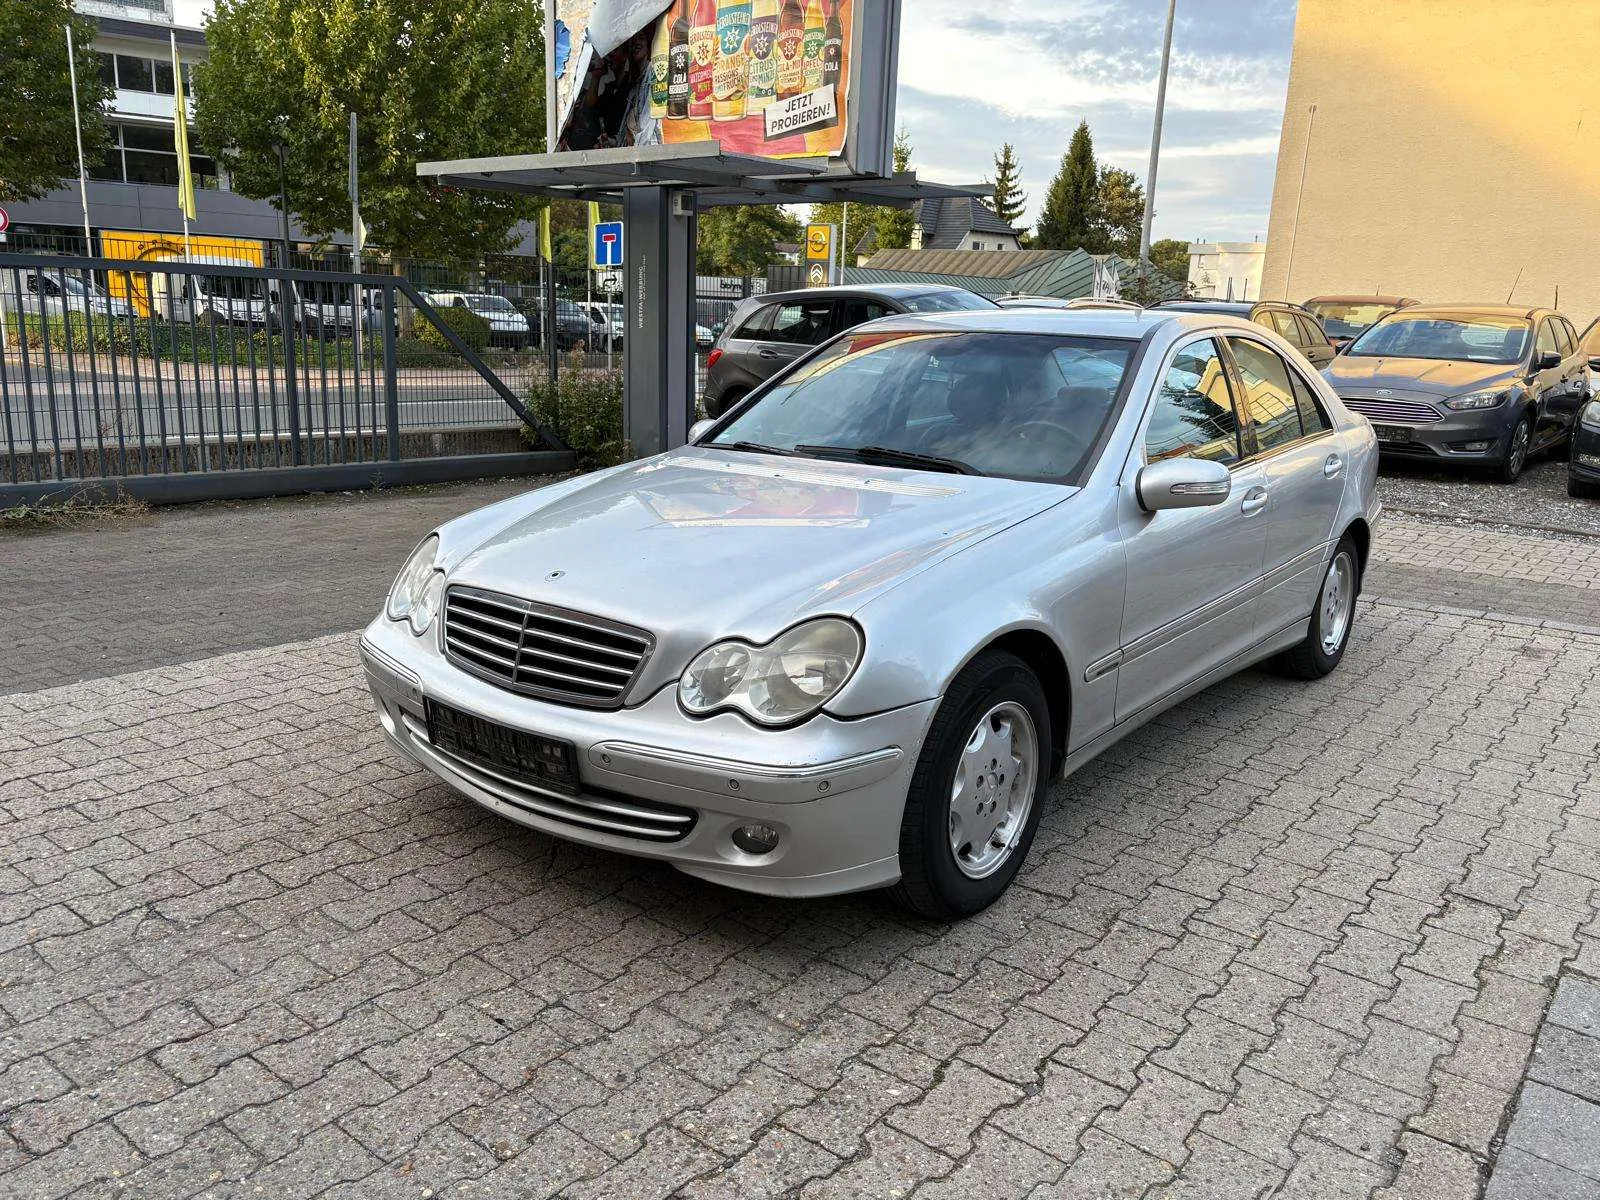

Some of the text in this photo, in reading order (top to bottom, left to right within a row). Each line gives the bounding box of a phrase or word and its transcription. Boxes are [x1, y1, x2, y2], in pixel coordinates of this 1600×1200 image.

[825, 61, 839, 71] COLA
[673, 72, 687, 84] COLA
[784, 93, 813, 113] JETZT
[771, 103, 830, 132] PROBIEREN!
